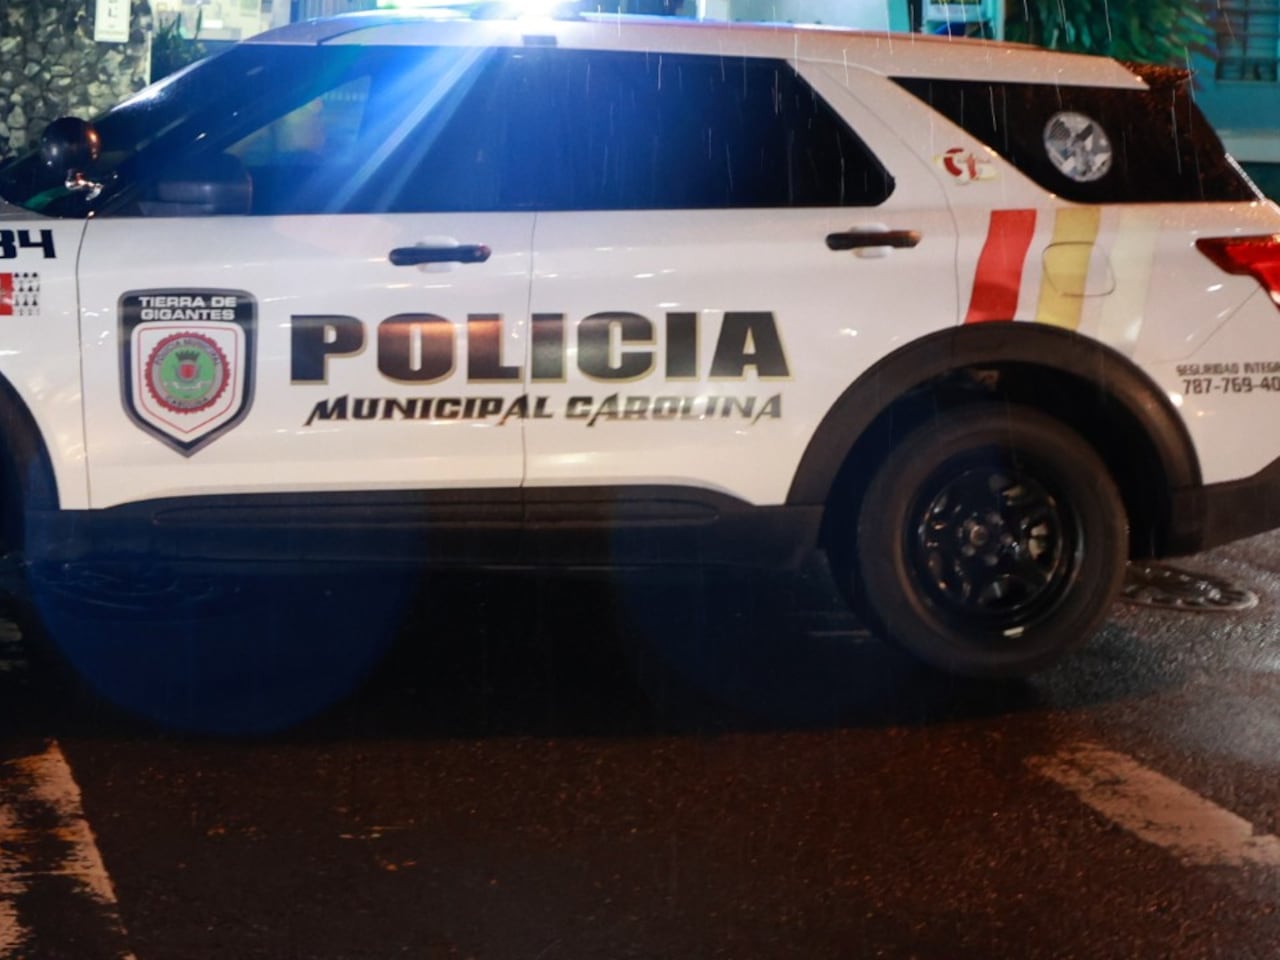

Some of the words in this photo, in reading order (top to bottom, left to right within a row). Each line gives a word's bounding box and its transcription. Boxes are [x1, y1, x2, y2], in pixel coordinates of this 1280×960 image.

[138, 296, 205, 308] TIERRA
[211, 296, 237, 307] DE
[140, 308, 236, 321] GIGANTES
[290, 311, 794, 386] POLICIA
[303, 393, 554, 427] MUNICIPAL
[565, 392, 783, 427] CAROLINA
